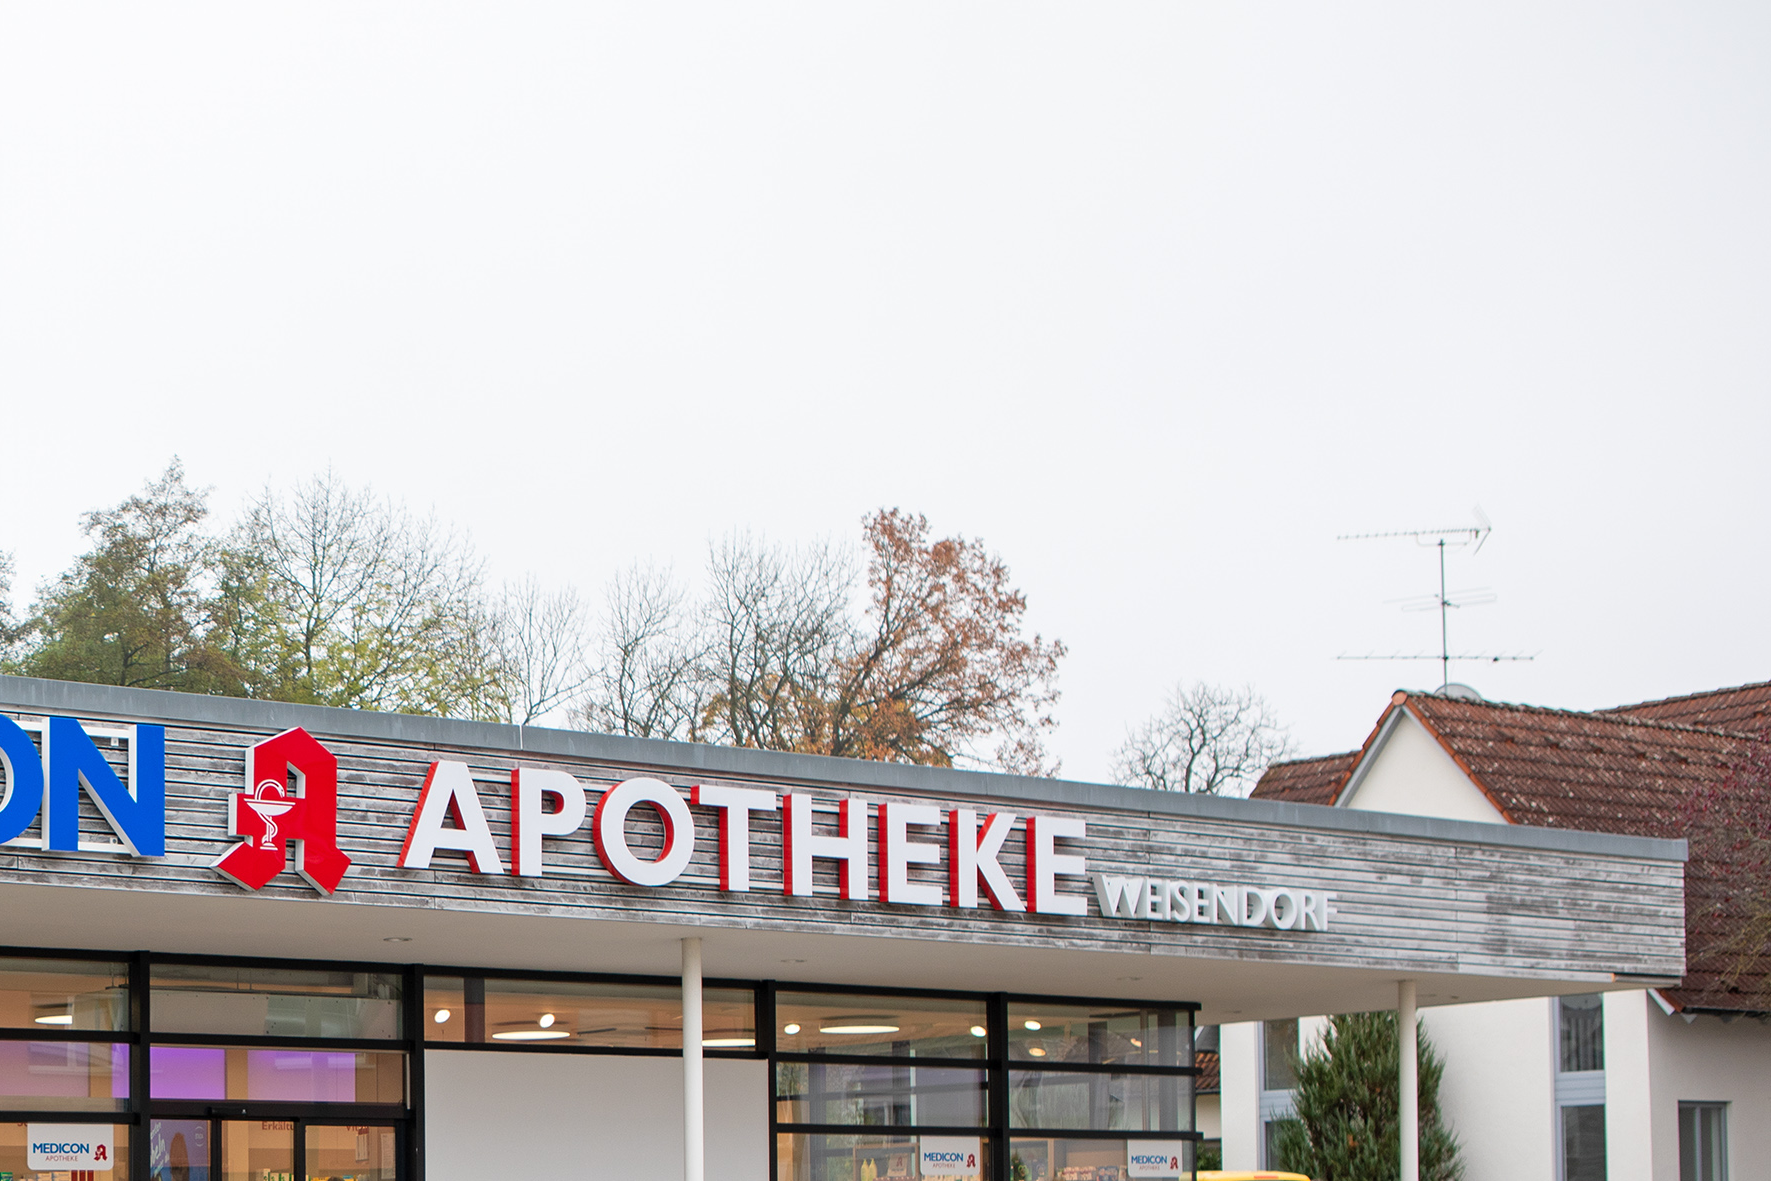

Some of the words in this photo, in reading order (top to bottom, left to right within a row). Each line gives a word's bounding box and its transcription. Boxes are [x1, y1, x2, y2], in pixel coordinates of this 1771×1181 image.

[396, 760, 1088, 916] APOTHEKE
[1090, 874, 1337, 933] WEISENDORF
[32, 1143, 89, 1154] MEDICON
[923, 1152, 964, 1162] MEDICON
[1131, 1155, 1168, 1164] MEDICON
